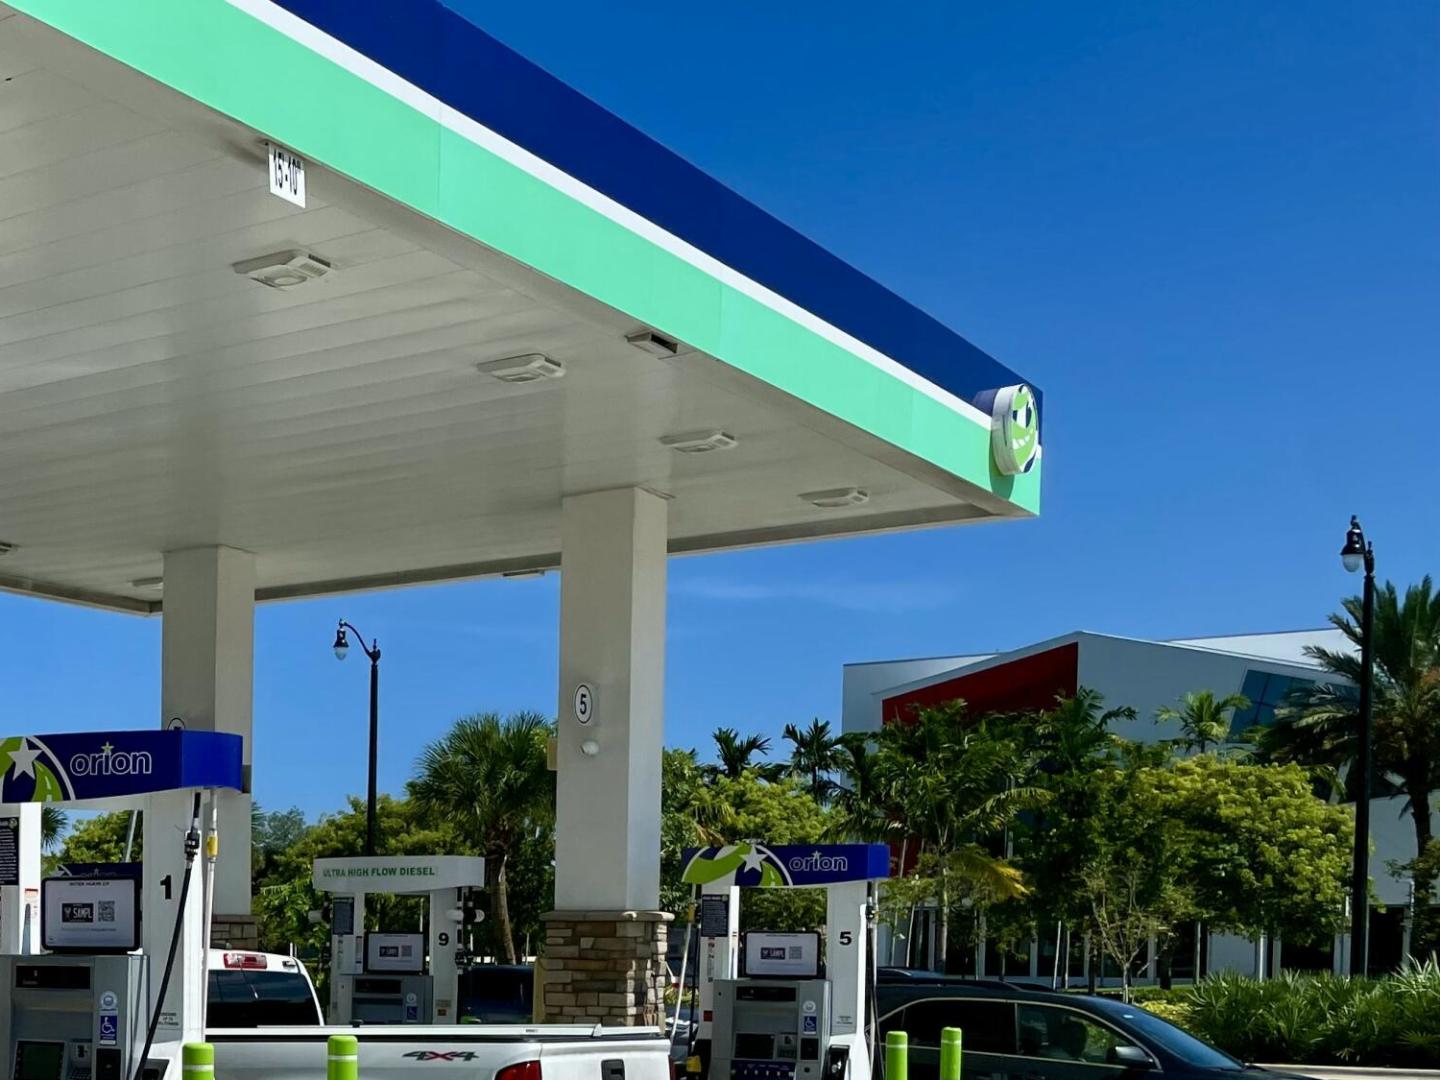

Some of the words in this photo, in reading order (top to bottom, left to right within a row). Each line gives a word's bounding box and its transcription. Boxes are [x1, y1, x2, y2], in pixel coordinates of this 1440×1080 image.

[579, 693, 587, 715] 5
[70, 741, 152, 776] orion
[788, 850, 848, 871] orion
[322, 868, 346, 878] ULTRA
[347, 867, 369, 877] HIGH
[371, 867, 397, 877] FLOW
[399, 866, 436, 876] DIESEL
[160, 874, 172, 900] 1
[438, 932, 449, 946] 9
[839, 931, 853, 946] 5
